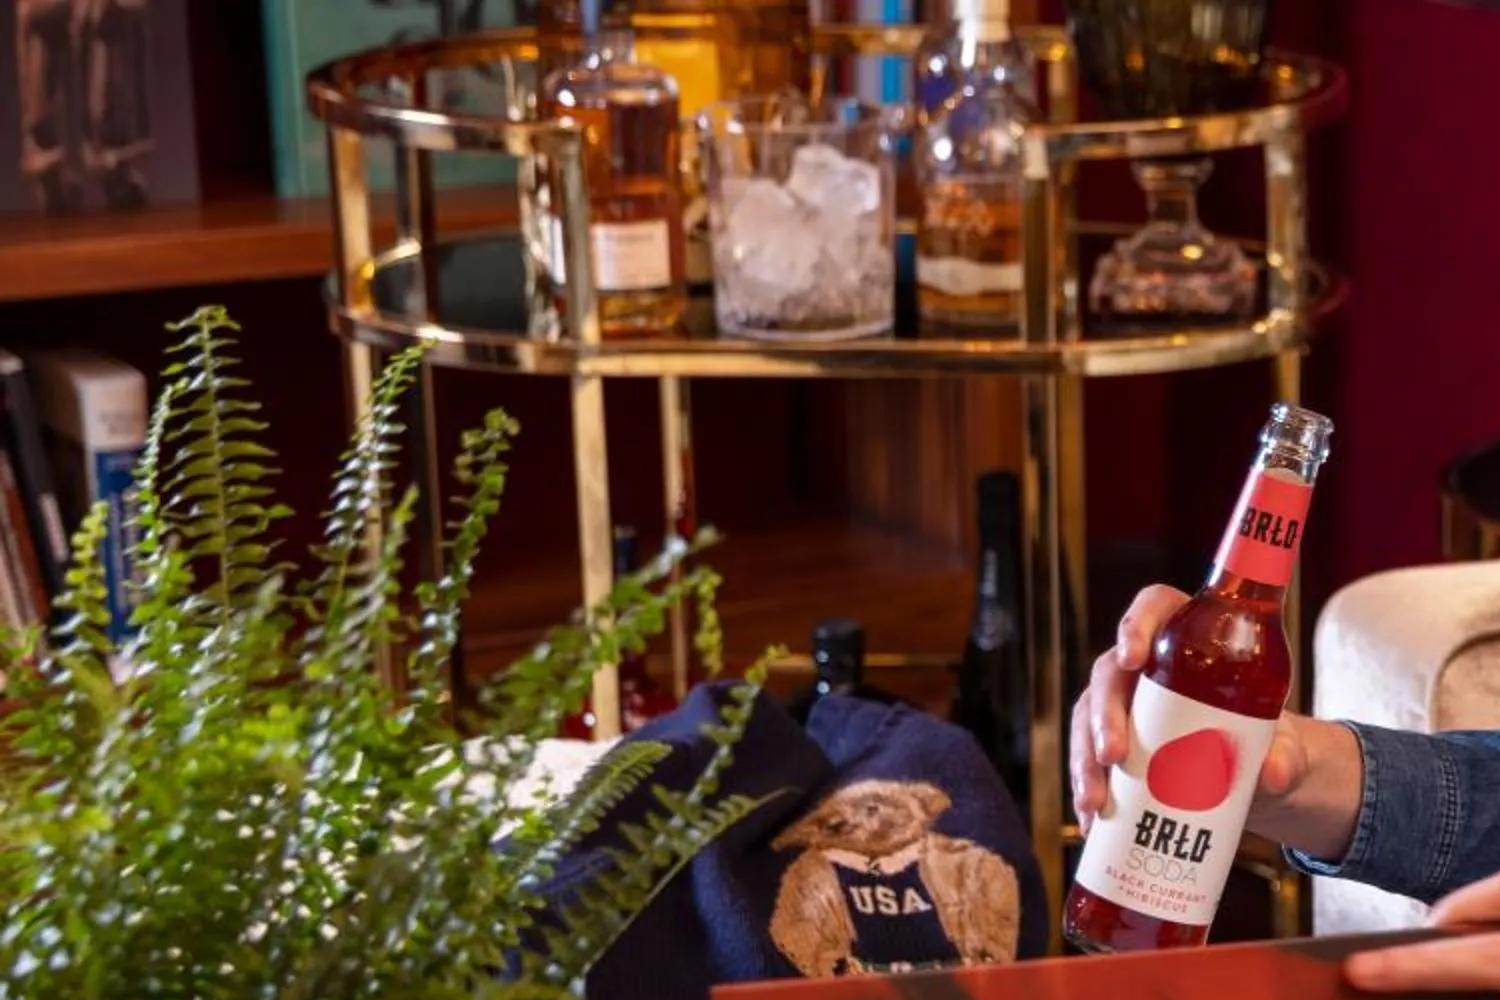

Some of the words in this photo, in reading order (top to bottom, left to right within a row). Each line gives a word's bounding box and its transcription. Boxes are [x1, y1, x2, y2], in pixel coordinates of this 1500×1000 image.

[1105, 866, 1146, 887] BLACK
[1127, 848, 1198, 885] SODA
[850, 886, 931, 915] USA
